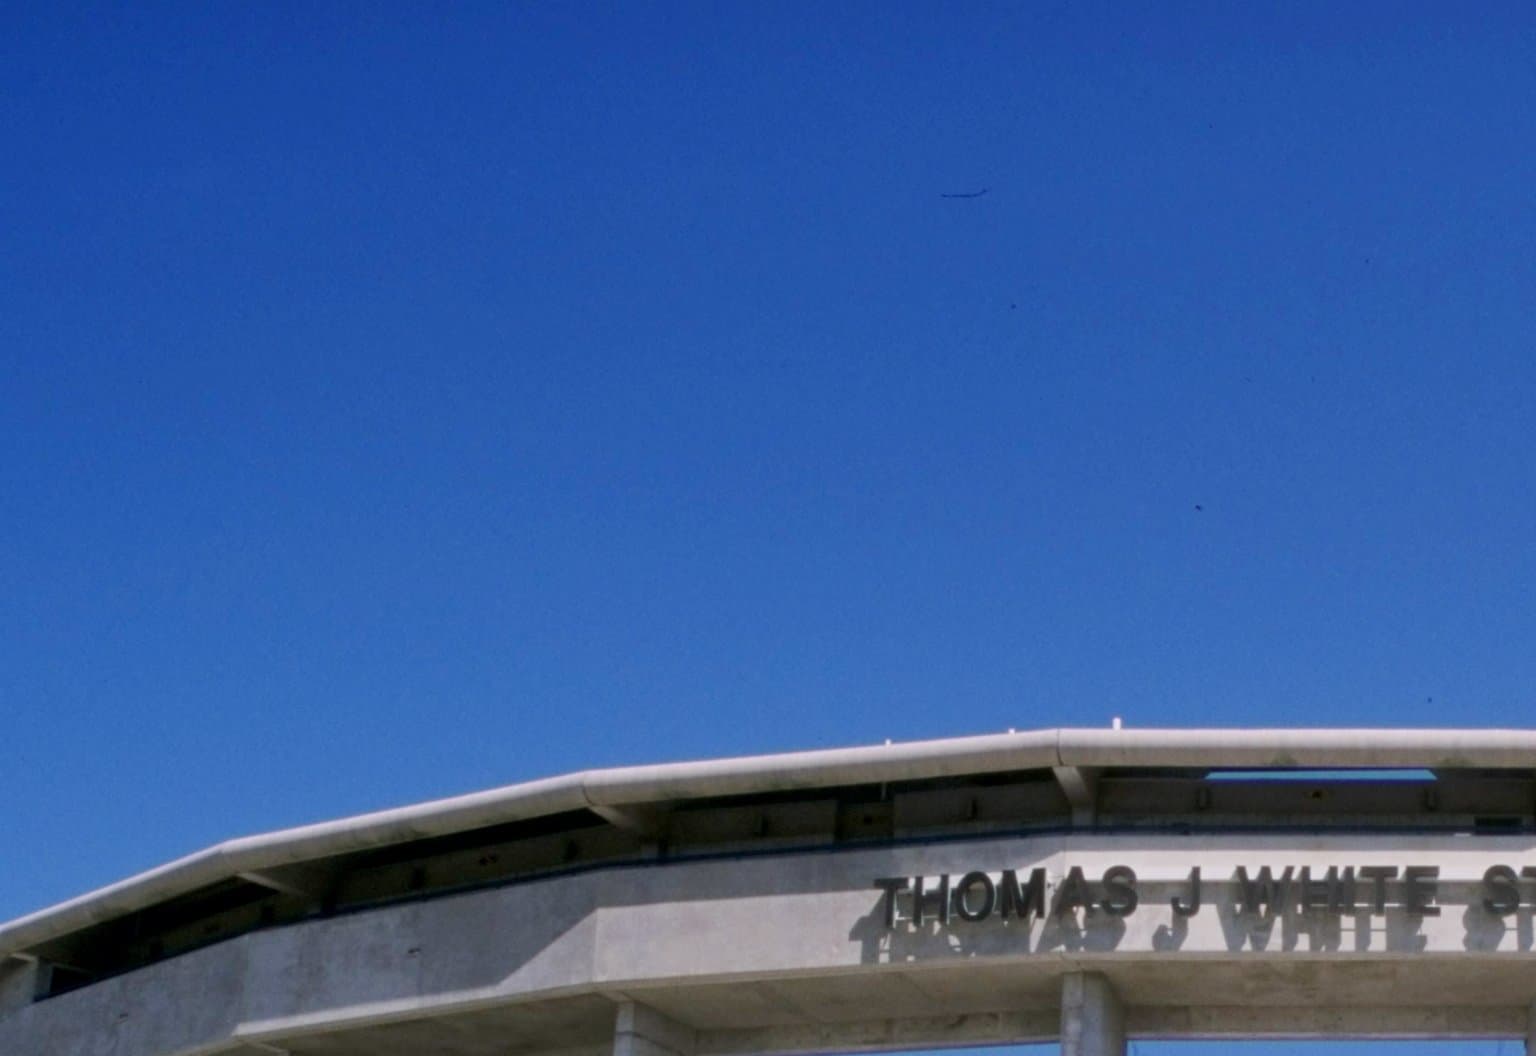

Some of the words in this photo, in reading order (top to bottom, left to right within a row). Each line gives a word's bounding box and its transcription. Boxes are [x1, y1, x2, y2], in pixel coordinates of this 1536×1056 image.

[874, 865, 1138, 929] THOMAS
[1171, 866, 1200, 918] J
[1236, 865, 1441, 917] WHITE
